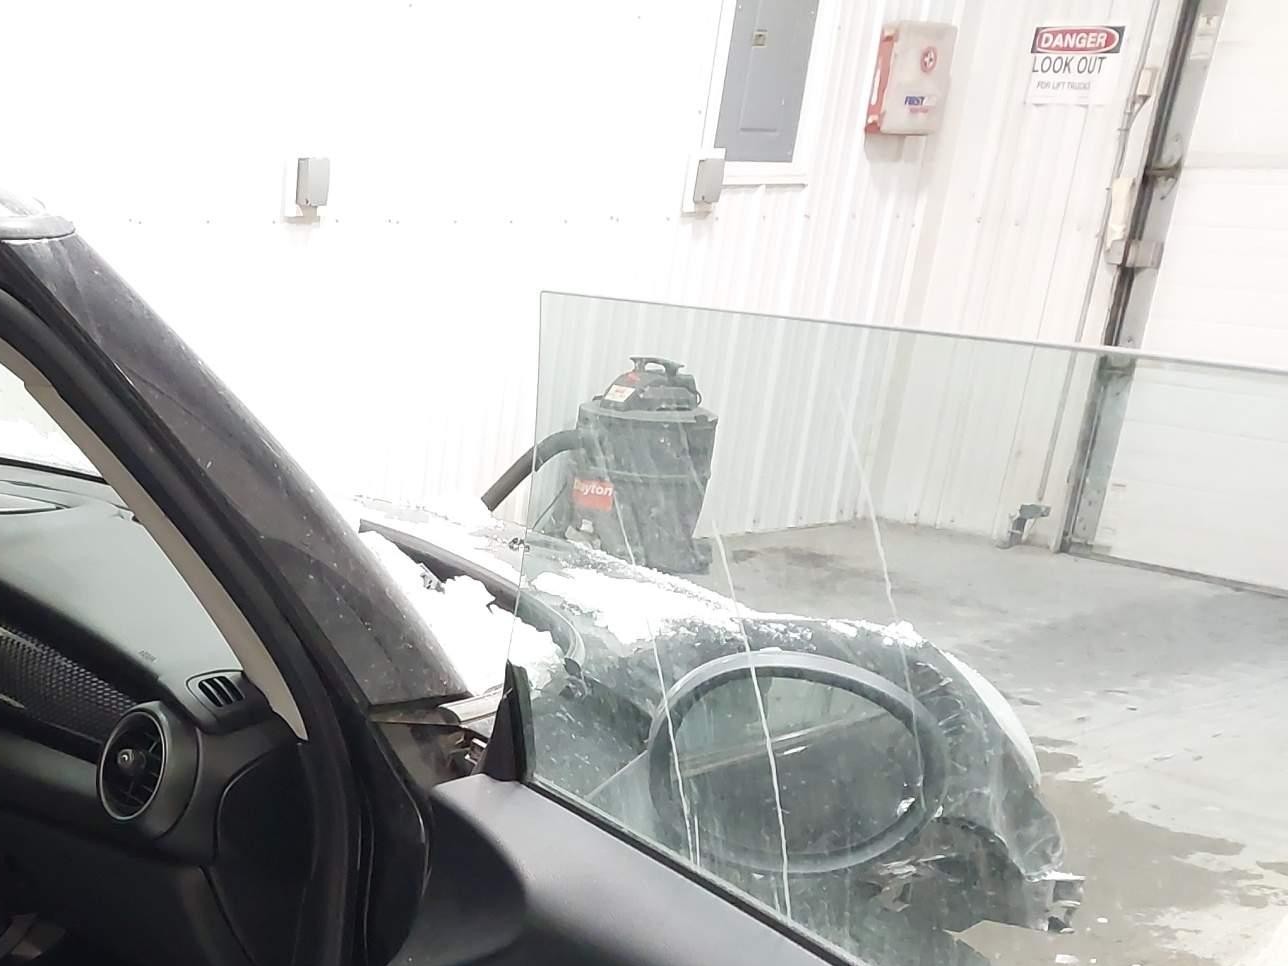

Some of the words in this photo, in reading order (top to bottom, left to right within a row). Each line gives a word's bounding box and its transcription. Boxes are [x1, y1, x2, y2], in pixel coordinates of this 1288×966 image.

[1040, 31, 1108, 49] DANGER
[1032, 56, 1074, 74] LOOK
[1077, 56, 1107, 74] OUT
[573, 478, 614, 497] yton
